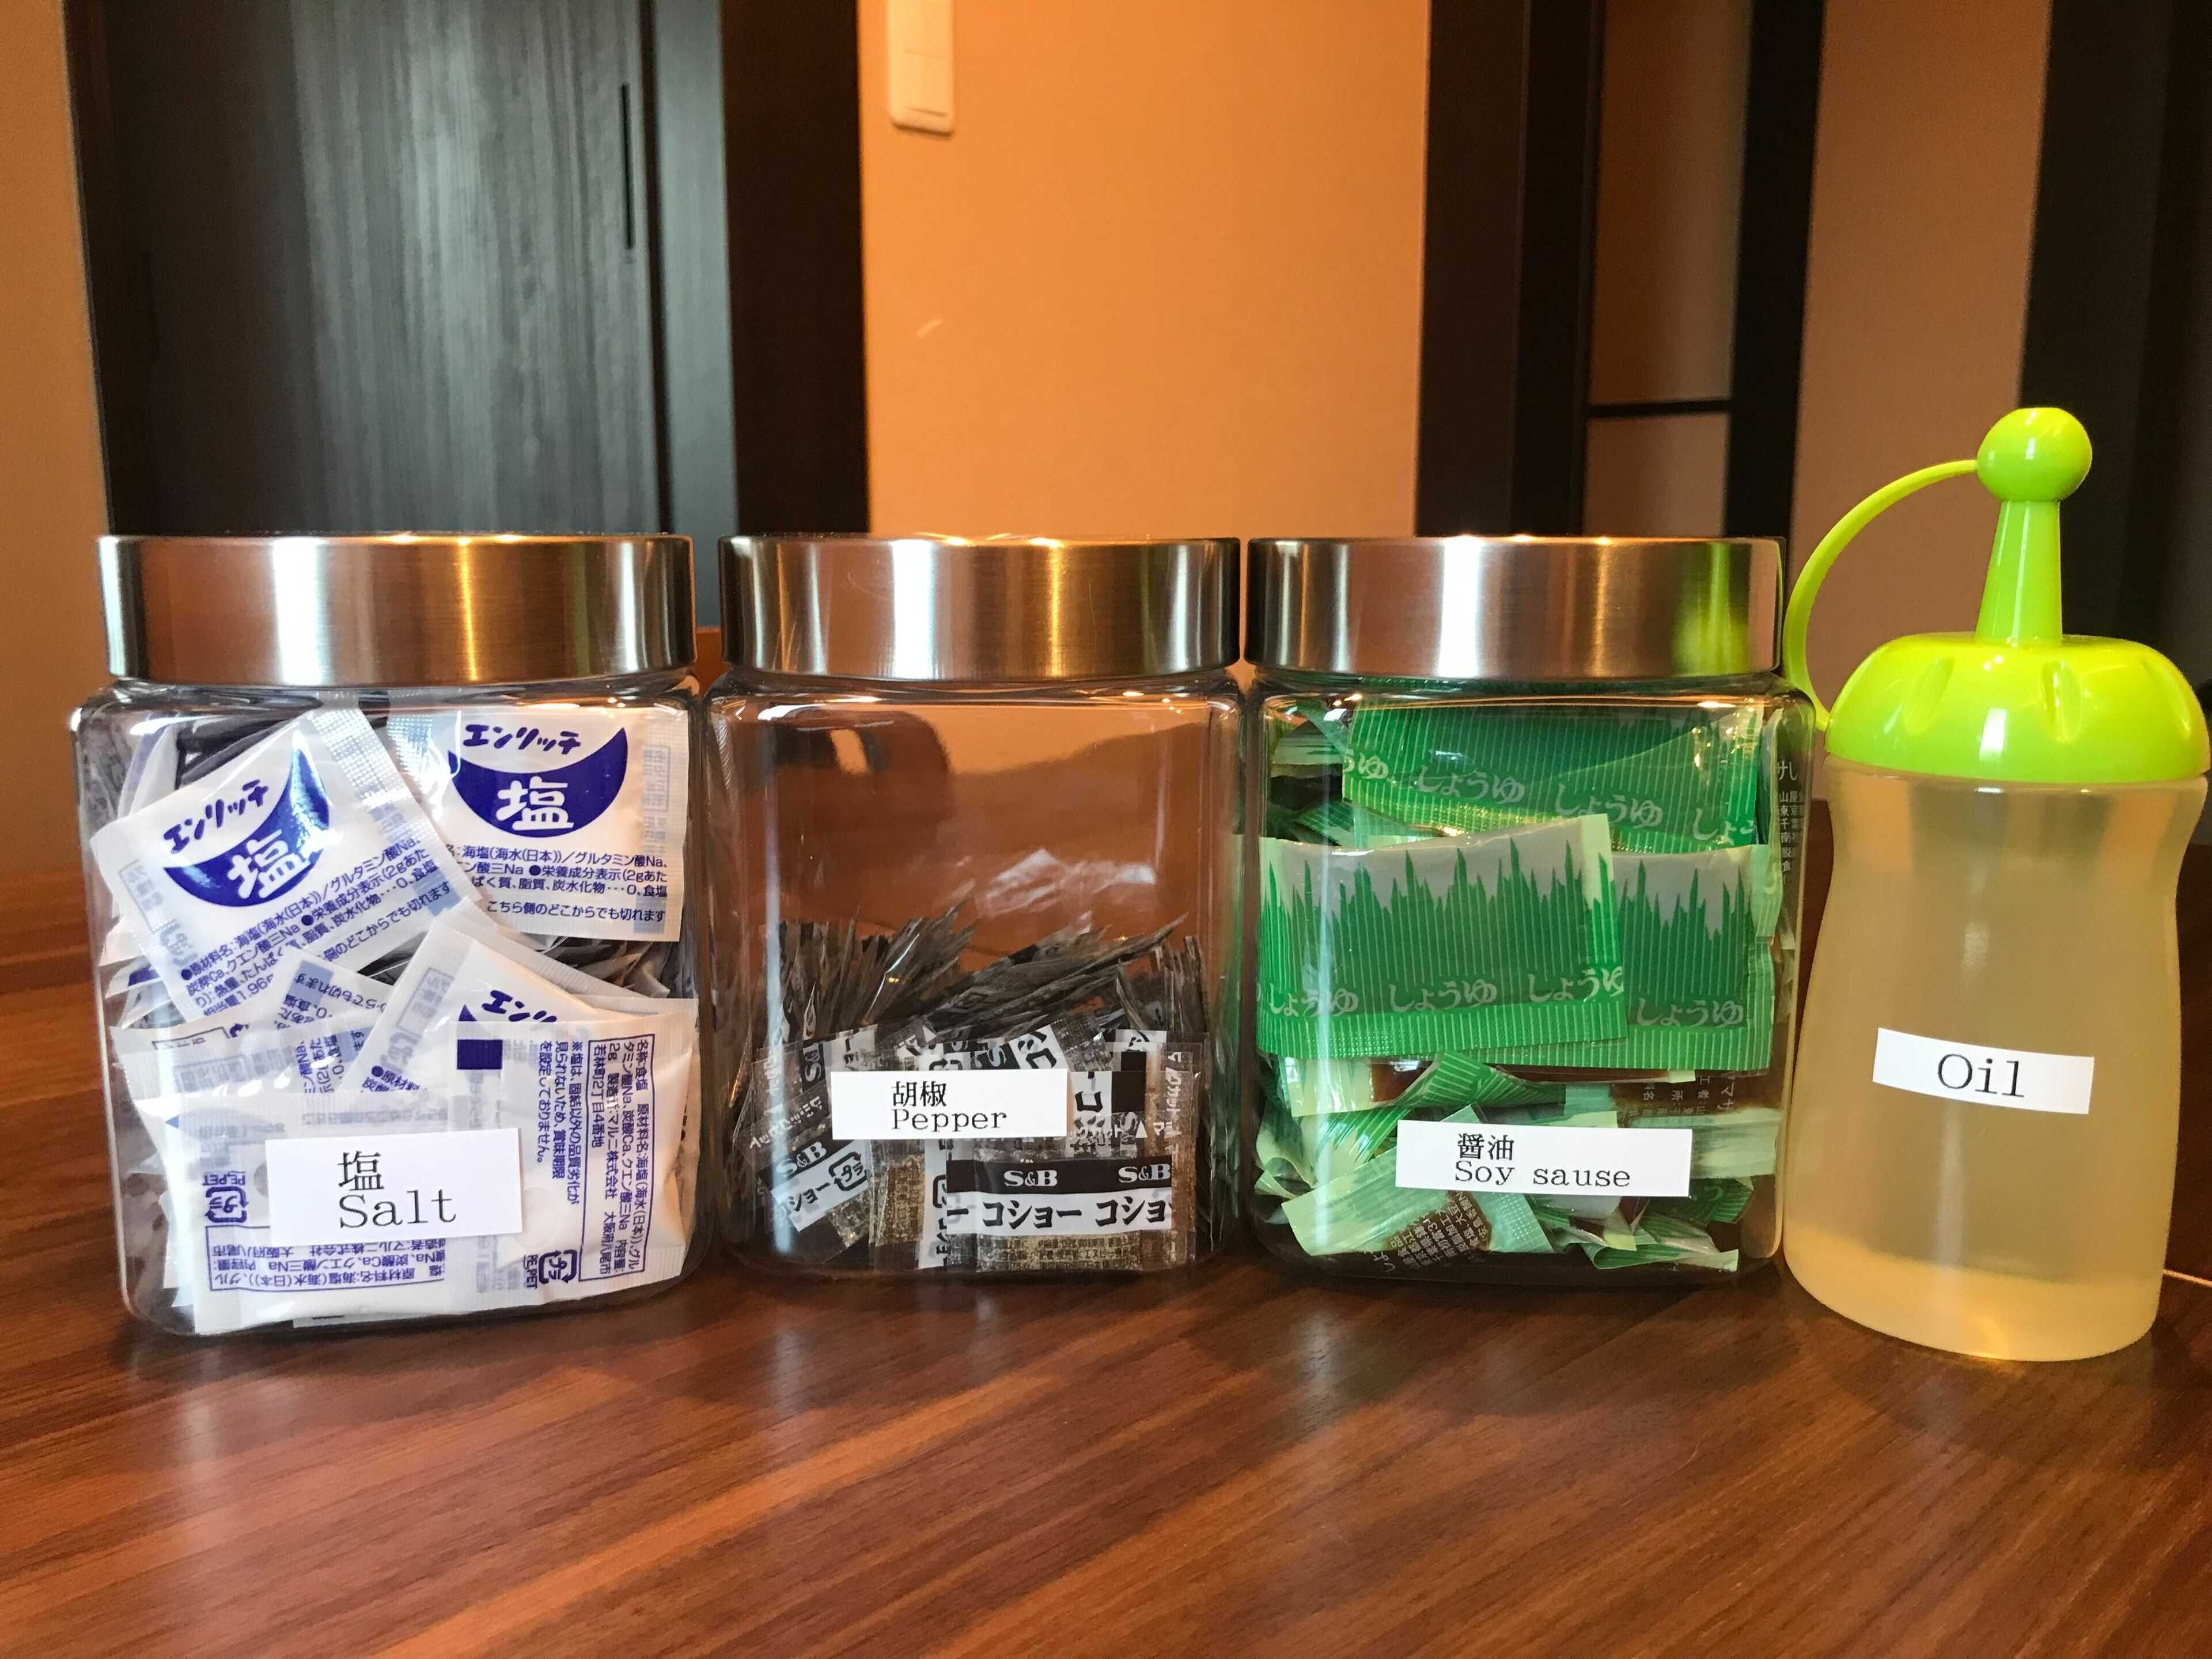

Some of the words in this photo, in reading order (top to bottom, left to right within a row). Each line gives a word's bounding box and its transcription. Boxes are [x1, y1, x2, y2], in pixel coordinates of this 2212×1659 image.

[463, 724, 581, 755] エンリッチ
[1417, 765, 1525, 804] しょうゆ
[164, 779, 269, 854] エンリッチ
[496, 775, 575, 831] 塩
[228, 829, 310, 899] 塩
[457, 861, 523, 874] ン酸三Na
[487, 901, 665, 922] こちら側のどこからでも切れます
[1269, 982, 1359, 1017] しょうゆ
[1389, 979, 1497, 1013] しょうゆ
[1636, 997, 1744, 1028] しょうゆ
[608, 1043, 620, 1061] 2g
[1937, 1054, 2024, 1097] Oil
[552, 1041, 569, 1179] 見られないため、賞味期限
[591, 1044, 607, 1149] 若林町2丁目4番地
[891, 1081, 946, 1107] 胡椒
[891, 1108, 1007, 1132] Pepper
[776, 1141, 828, 1177] S&B
[1457, 1133, 1514, 1160] 醤油
[338, 1151, 384, 1191] 塩
[1003, 1169, 1058, 1187] S&B
[1118, 1163, 1171, 1184] S&B
[1455, 1161, 1515, 1185] Soy
[1533, 1168, 1631, 1187] sause
[339, 1189, 457, 1229] Salt
[982, 1199, 1082, 1230] コショー
[1095, 1196, 1172, 1228] コショ
[600, 1210, 616, 1275] 大阪府八尾市
